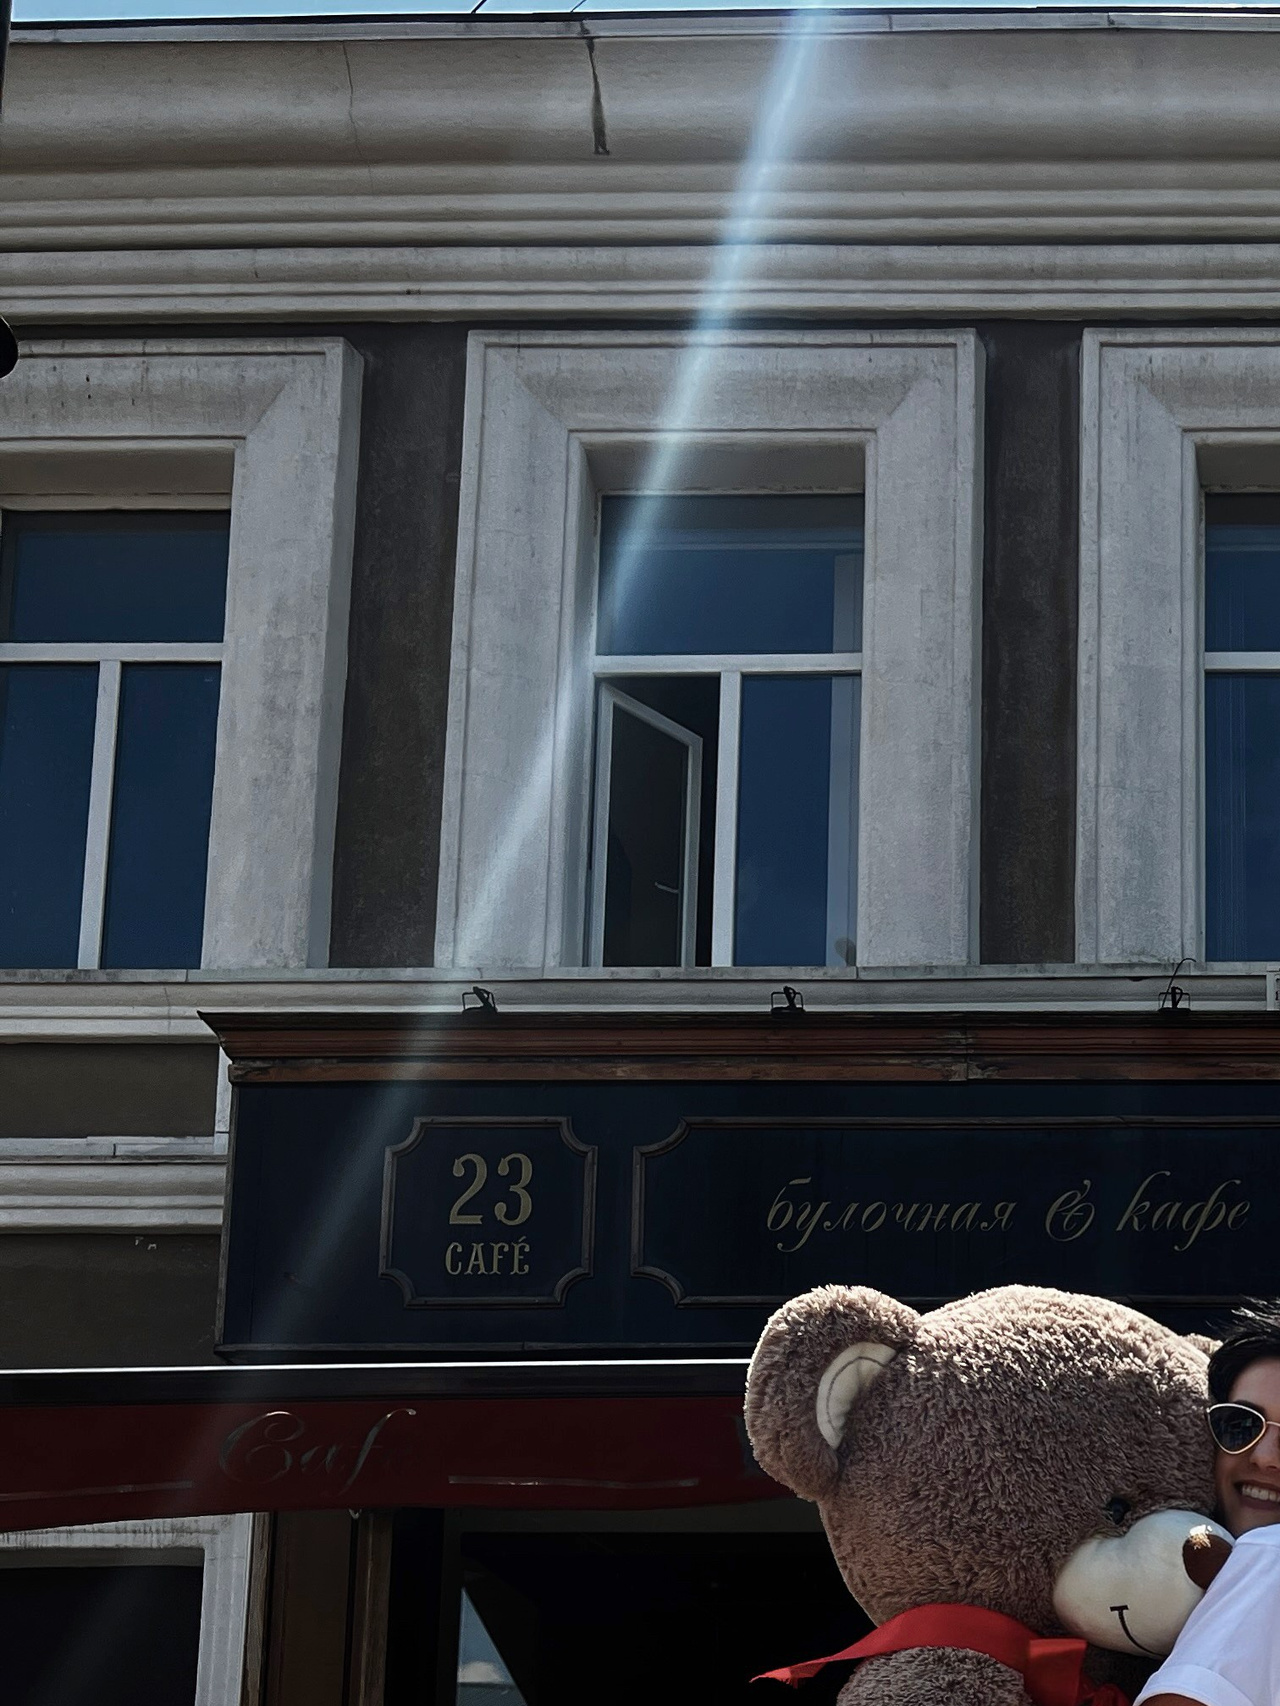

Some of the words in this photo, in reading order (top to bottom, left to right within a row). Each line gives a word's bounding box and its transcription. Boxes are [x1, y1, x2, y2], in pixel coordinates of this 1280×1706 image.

[449, 1152, 534, 1226] 23
[766, 1176, 1016, 1253] булочная
[1044, 1178, 1096, 1242] &
[1115, 1170, 1252, 1252] кафе
[444, 1235, 530, 1276] CAFÉ
[219, 1408, 417, 1498] Caf
